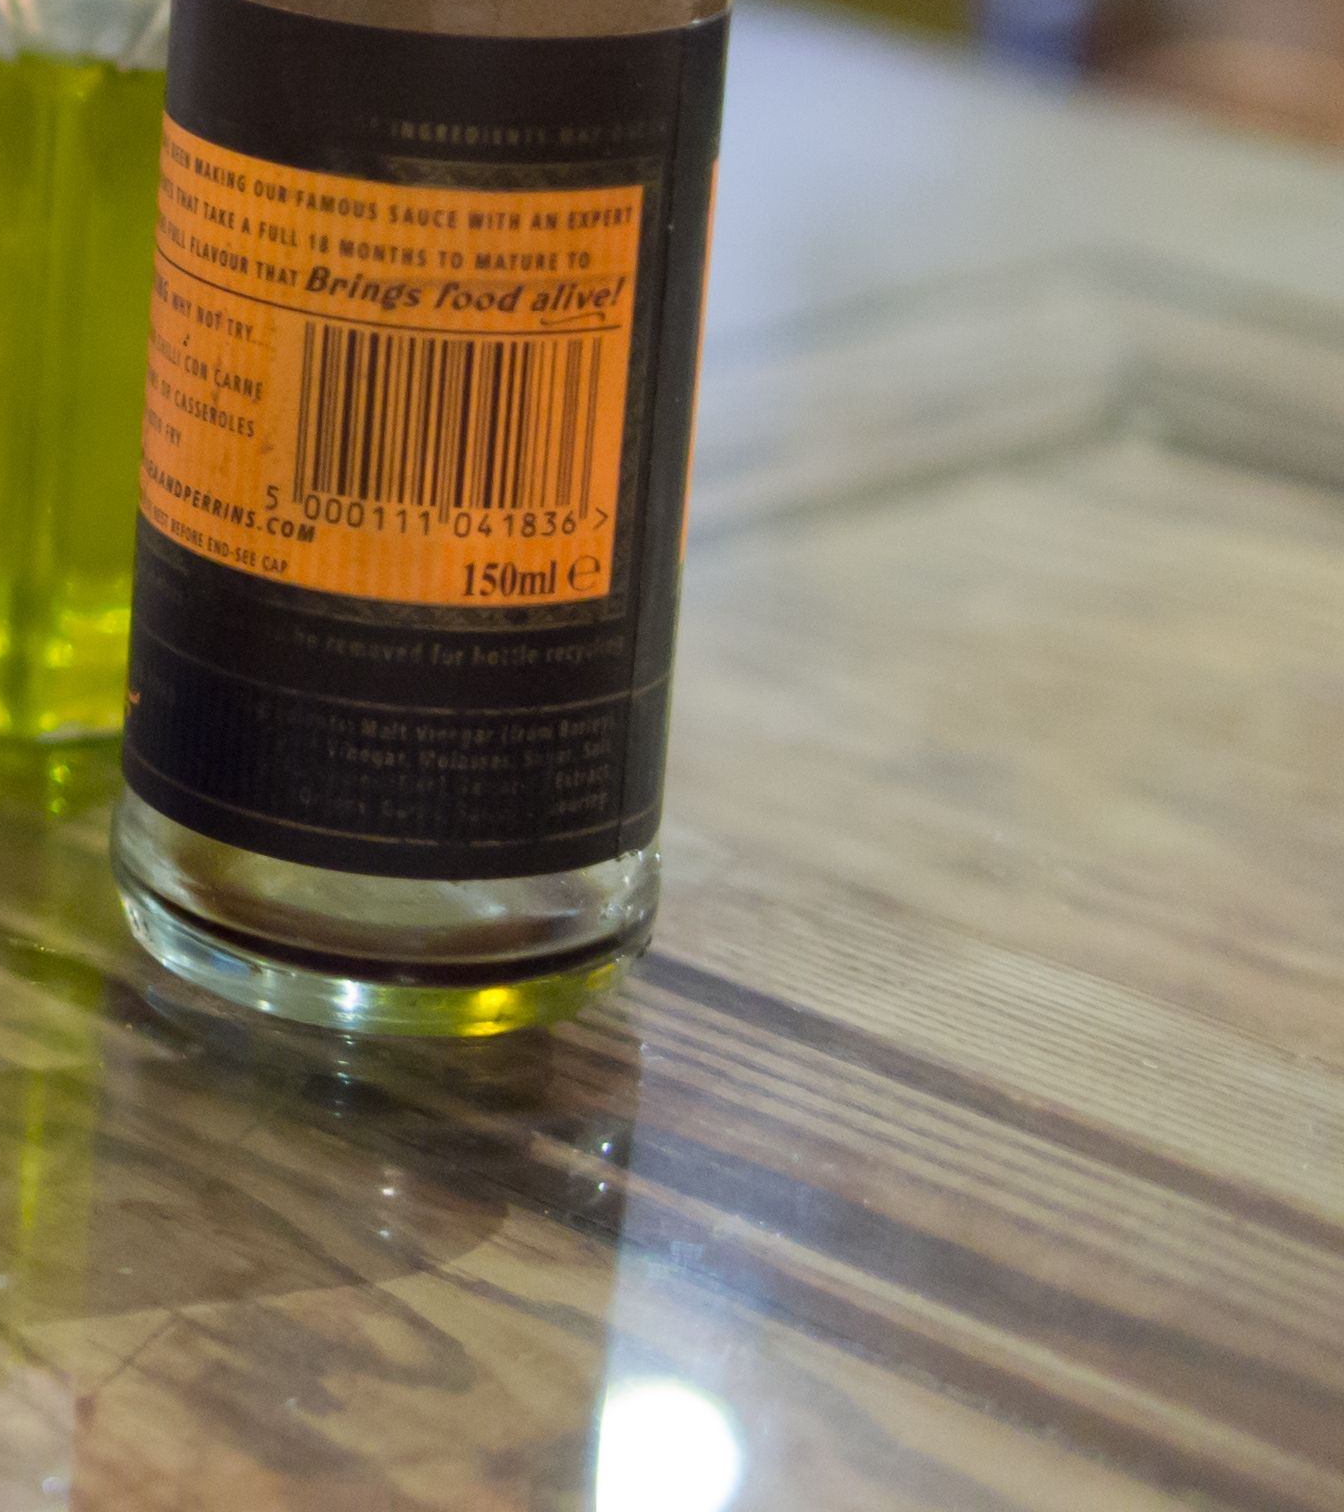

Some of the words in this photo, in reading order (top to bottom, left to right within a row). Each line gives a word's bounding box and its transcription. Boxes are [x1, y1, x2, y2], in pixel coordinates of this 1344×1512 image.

[194, 156, 247, 193] MAKING
[253, 179, 288, 204] OUR
[294, 189, 378, 222] FAMOUS
[388, 204, 458, 230] SAUCE
[467, 211, 521, 232] WITH
[529, 211, 559, 231] AN
[567, 205, 633, 231] EXPERT
[203, 201, 235, 231] TAKE
[240, 216, 251, 235] A
[259, 220, 298, 248] FULL
[309, 232, 330, 255] 18
[338, 239, 427, 268] MONTHS
[439, 250, 464, 270] TO
[474, 251, 558, 272] MATURE
[567, 250, 592, 270] TO
[189, 235, 250, 275] FLAVOUR
[255, 259, 299, 288] THAT
[304, 265, 423, 311] Brings
[434, 280, 525, 313] food
[529, 275, 627, 314] alive!
[196, 304, 223, 331] NOT
[184, 353, 208, 382] CON
[213, 367, 264, 402] CARNE
[173, 388, 255, 439] CASSEROLES
[265, 484, 280, 512] 5
[304, 493, 431, 537] 000111
[454, 510, 577, 539] 041836
[262, 555, 289, 574] CAP
[463, 559, 558, 598] 150ml
